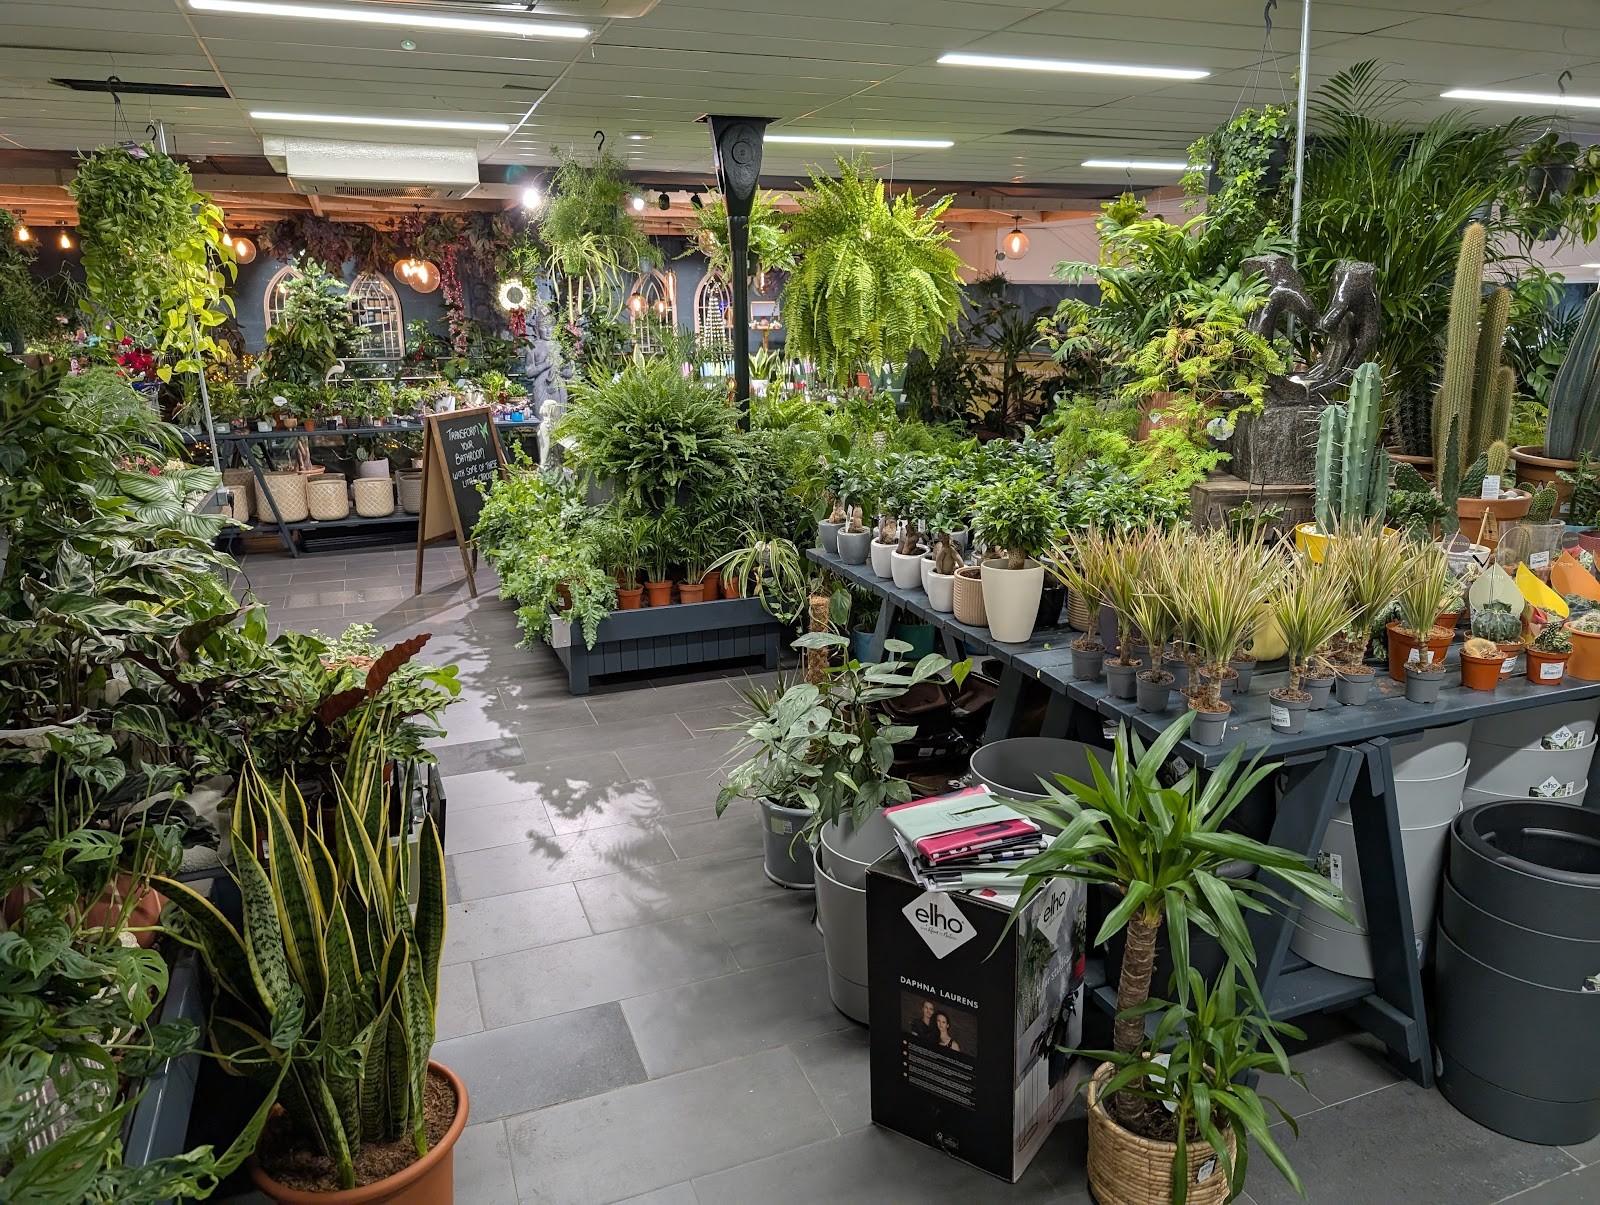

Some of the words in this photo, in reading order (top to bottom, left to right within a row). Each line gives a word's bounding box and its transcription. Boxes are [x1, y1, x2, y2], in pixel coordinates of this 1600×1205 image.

[446, 424, 480, 441] TRANSFORM
[460, 440, 474, 450] YOUR
[455, 447, 485, 465] BATHROOM
[485, 459, 498, 470] THESE
[1554, 731, 1570, 739] elho
[1542, 781, 1558, 790] elho
[1043, 890, 1066, 923] elho
[915, 902, 963, 934] elho
[900, 975, 937, 995] DAPHNA
[939, 989, 979, 1009] LAURENS
